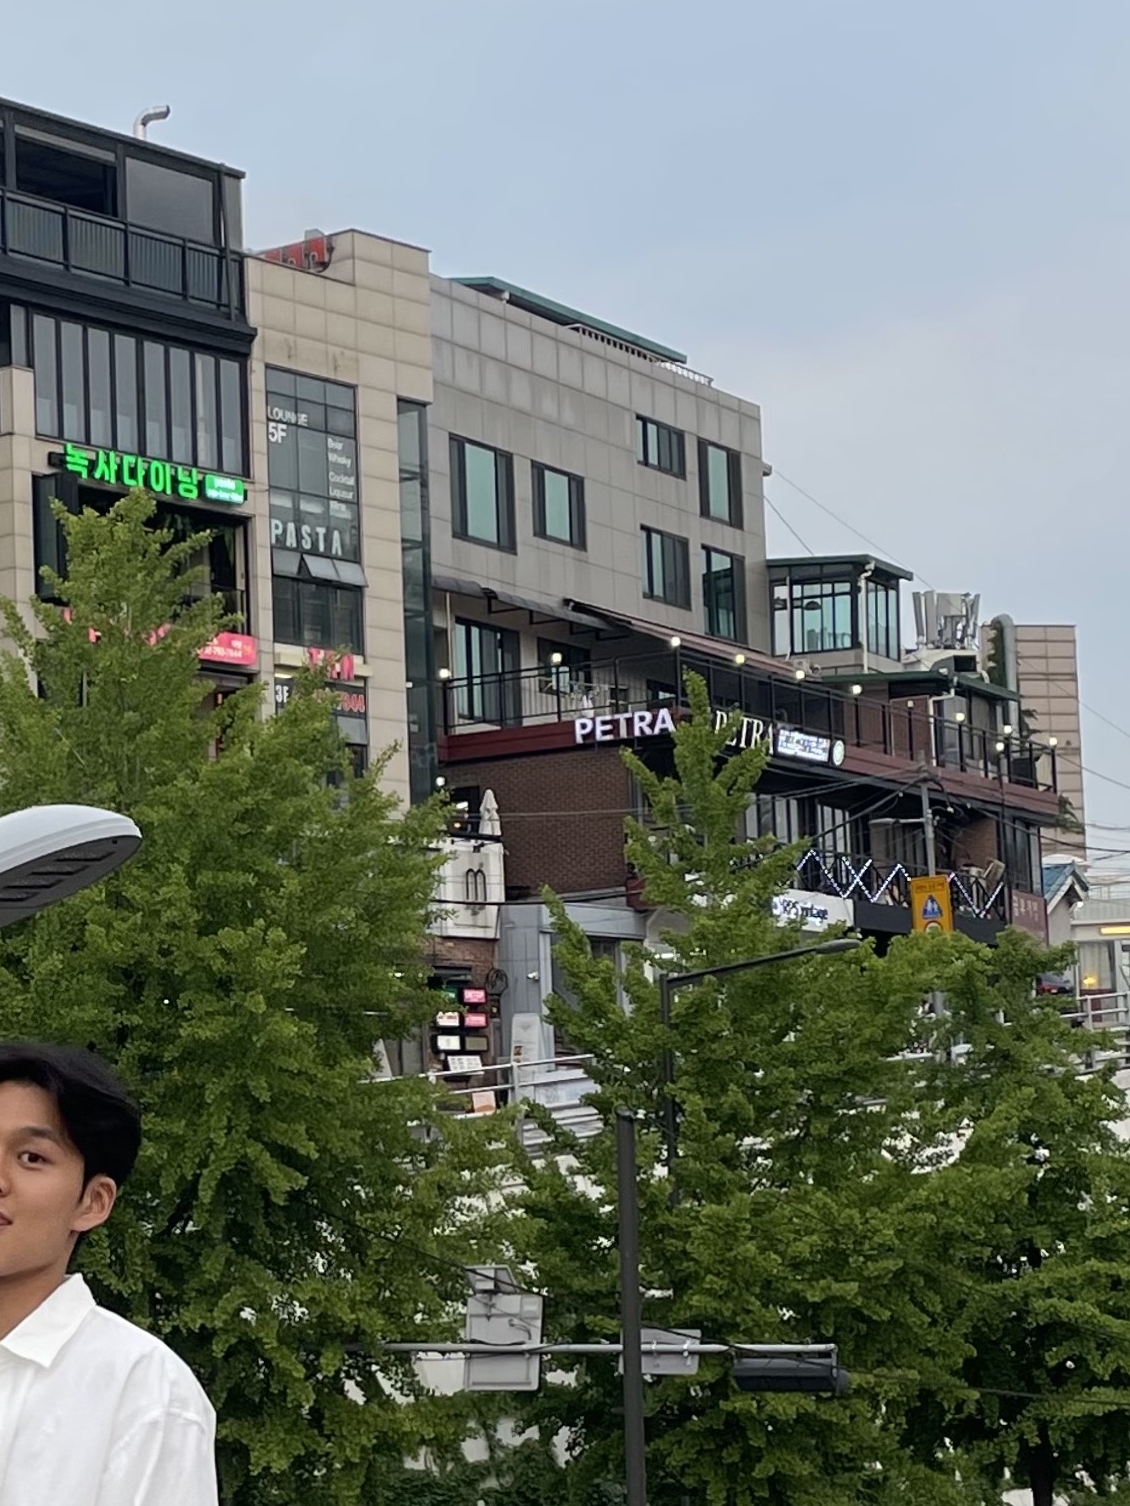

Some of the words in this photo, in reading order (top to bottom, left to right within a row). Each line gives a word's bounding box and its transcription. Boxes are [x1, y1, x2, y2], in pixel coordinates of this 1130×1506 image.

[267, 405, 309, 428] LOUNGE
[268, 422, 287, 444] 5F
[65, 443, 199, 499] 녹사다이닝
[270, 518, 343, 556] PASTA
[275, 684, 289, 703] 3F
[574, 707, 676, 744] PETRA
[714, 710, 774, 758] PTRA
